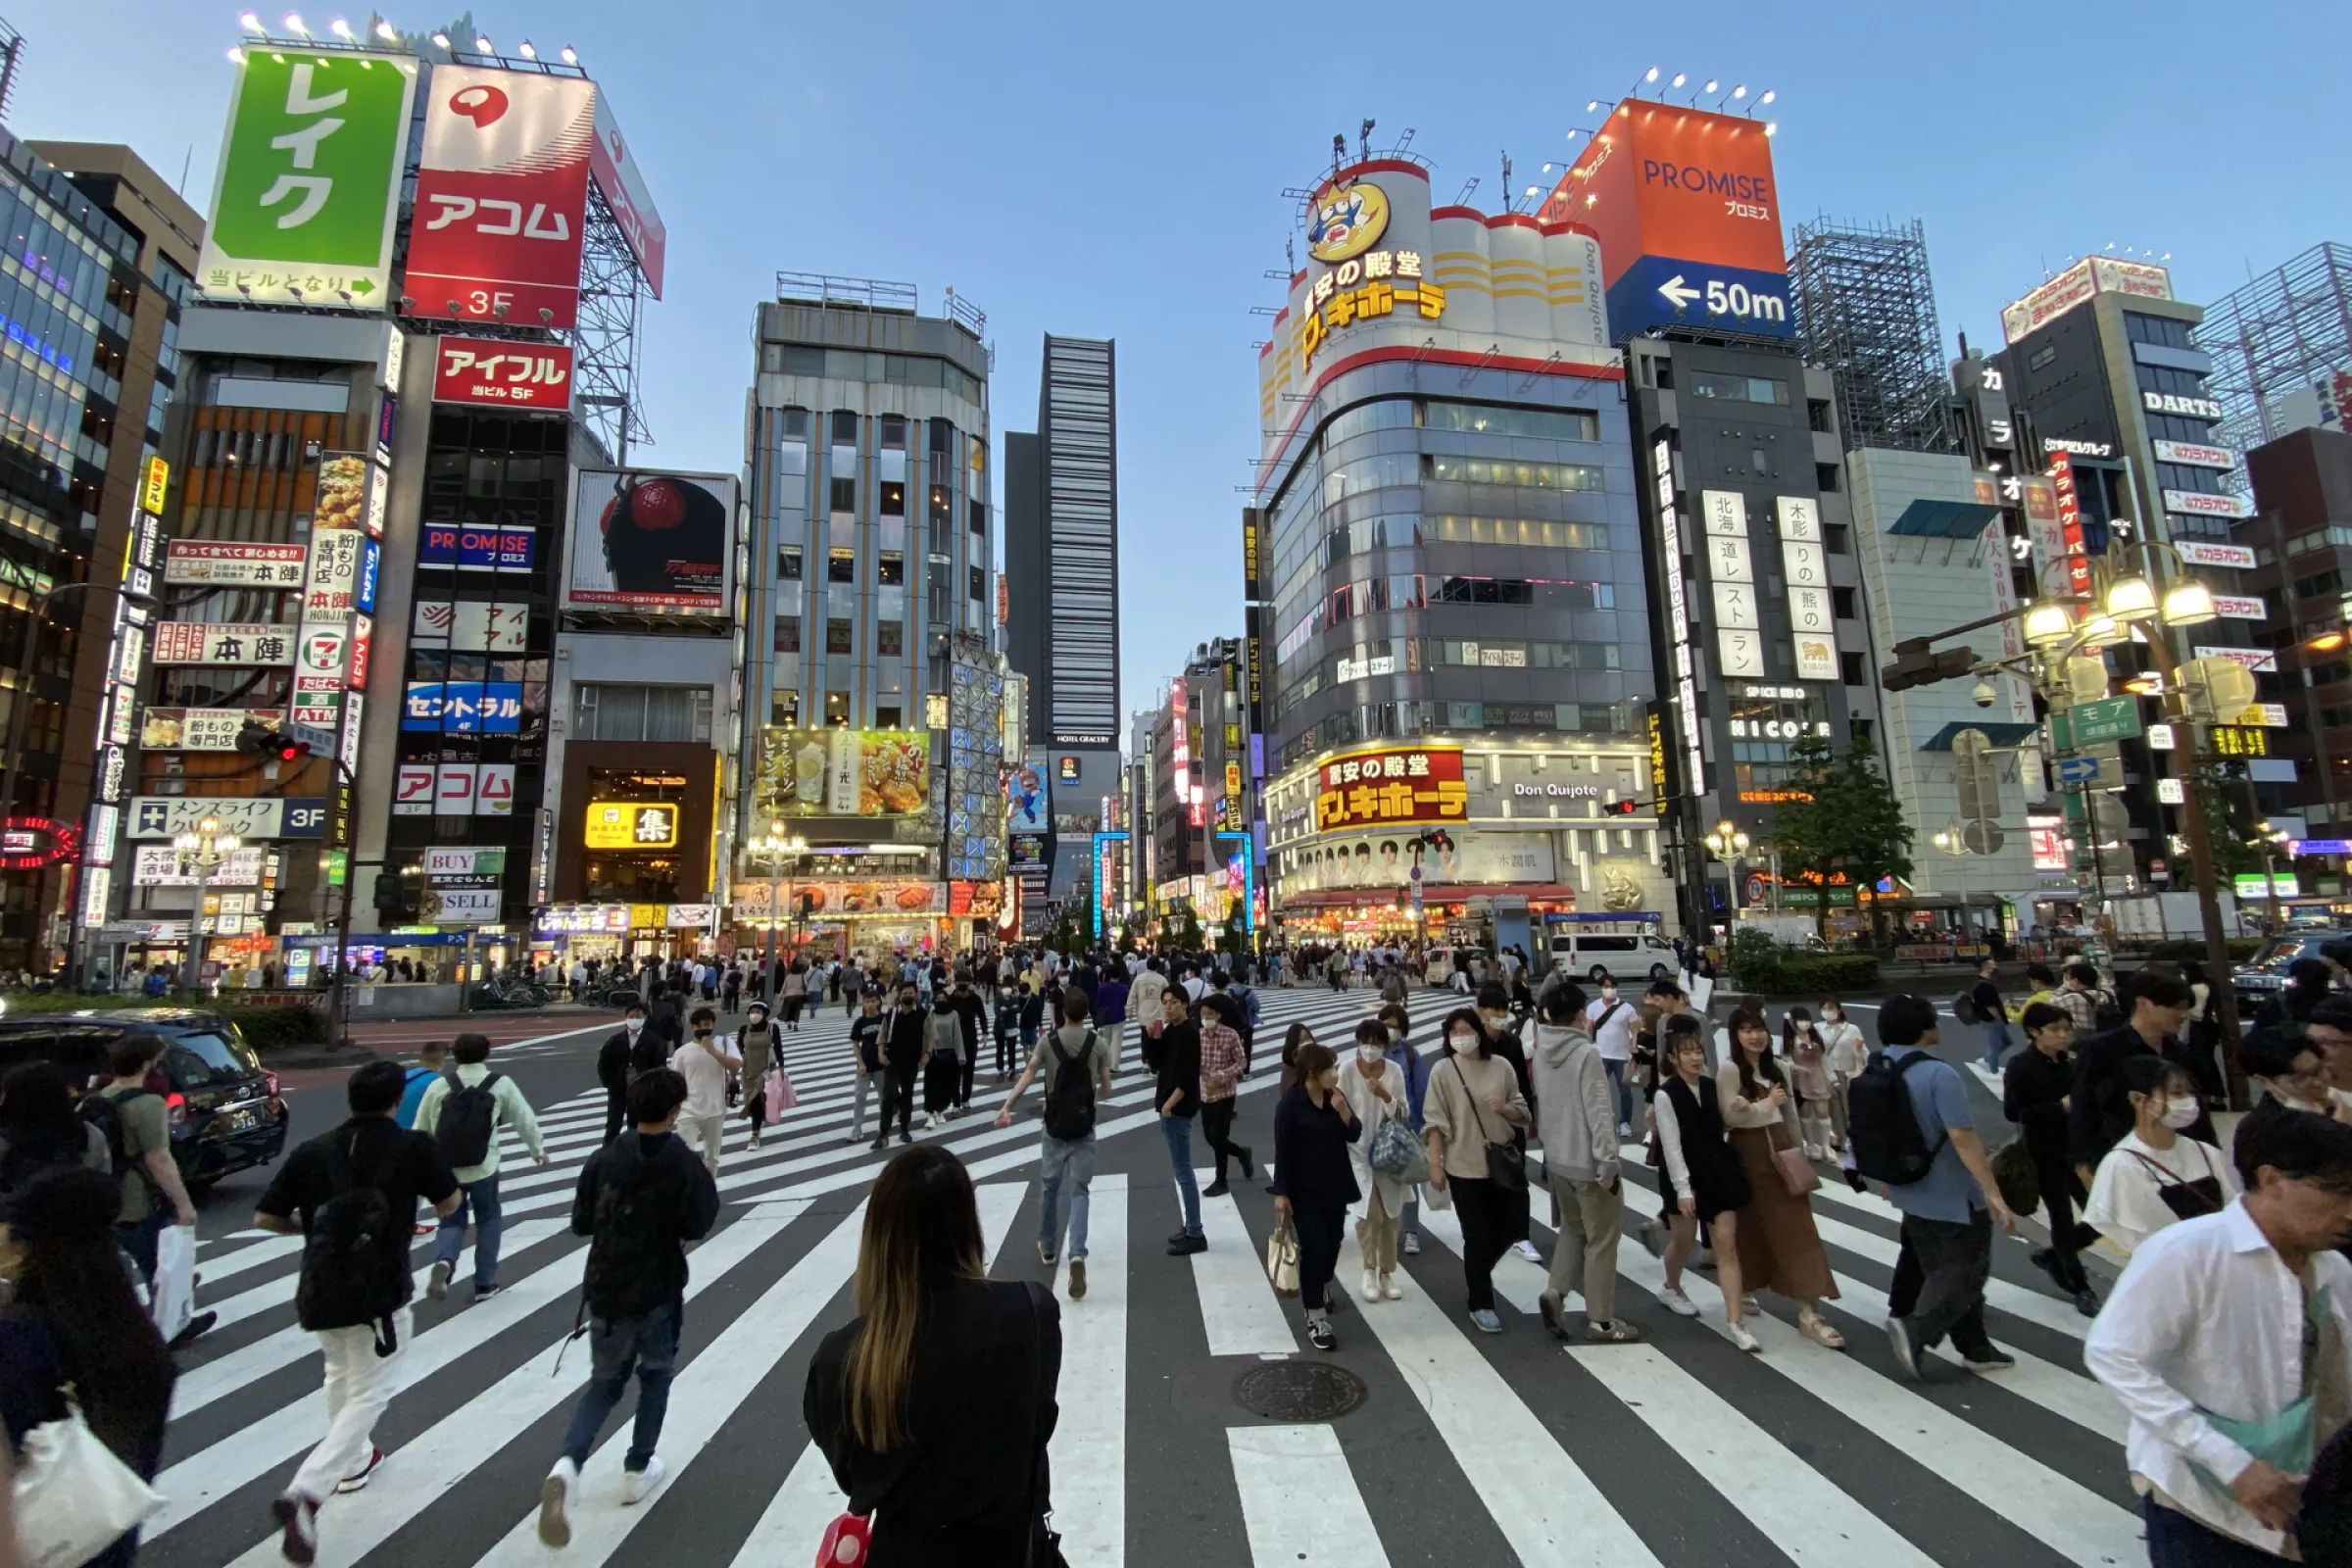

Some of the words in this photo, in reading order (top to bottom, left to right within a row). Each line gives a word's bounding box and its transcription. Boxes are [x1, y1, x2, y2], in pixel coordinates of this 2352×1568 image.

[260, 64, 348, 230] レイク
[1582, 143, 1613, 185] プロミス
[1643, 159, 1769, 202] PROMISE
[426, 194, 569, 241] アコム
[612, 177, 647, 260] アコム
[1724, 201, 1771, 221] プロミス
[1585, 241, 1597, 275] Don
[209, 270, 348, 295] 当ビルとなり
[468, 291, 515, 314] 3F
[1588, 278, 1603, 345] Quijote
[1706, 279, 1787, 322] 50m
[445, 350, 565, 384] アイフル
[471, 385, 507, 397] 当ビル
[511, 387, 534, 399] 5F
[2144, 391, 2222, 417] DARTS
[1982, 368, 2034, 560] カラオケ
[2180, 447, 2221, 463] カラオケ
[2052, 461, 2078, 525] カラオケ
[2191, 496, 2232, 513] カラオケ
[429, 531, 528, 552] PROMISE
[315, 540, 336, 583] 専門店
[335, 533, 356, 577] 粉もの
[486, 552, 525, 563] プロミス
[1789, 503, 1820, 627] 木彫りの熊の
[2201, 548, 2243, 563] カラオケ
[254, 564, 299, 581] 本陣
[1716, 496, 1750, 671] 北海道レストラン
[308, 590, 352, 609] 本陣
[1667, 542, 1684, 635] KIBORI
[310, 611, 349, 621] HONJIN
[215, 636, 285, 662] 本陣
[303, 678, 340, 691] たばこ
[310, 694, 329, 706] 酒
[408, 695, 521, 718] セントラル
[2082, 701, 2126, 720] モア
[191, 719, 234, 732] 粉もの
[297, 710, 337, 721] ATM
[458, 721, 472, 730] 4F
[190, 734, 233, 747] 専門店
[344, 699, 359, 766] 東京ぶらん
[1328, 754, 1430, 785] 驚安の殿堂
[400, 773, 512, 799] アコム
[1514, 783, 1544, 796] Don
[1546, 783, 1598, 799] Quijote
[172, 801, 273, 815] メンズライフ
[290, 808, 326, 828] 3F
[404, 805, 422, 813] 3F
[171, 819, 253, 834] クリック
[635, 808, 672, 842] 集
[432, 856, 472, 870] BUY
[1498, 853, 1538, 868] 水潤肌
[446, 895, 496, 909] SELL
